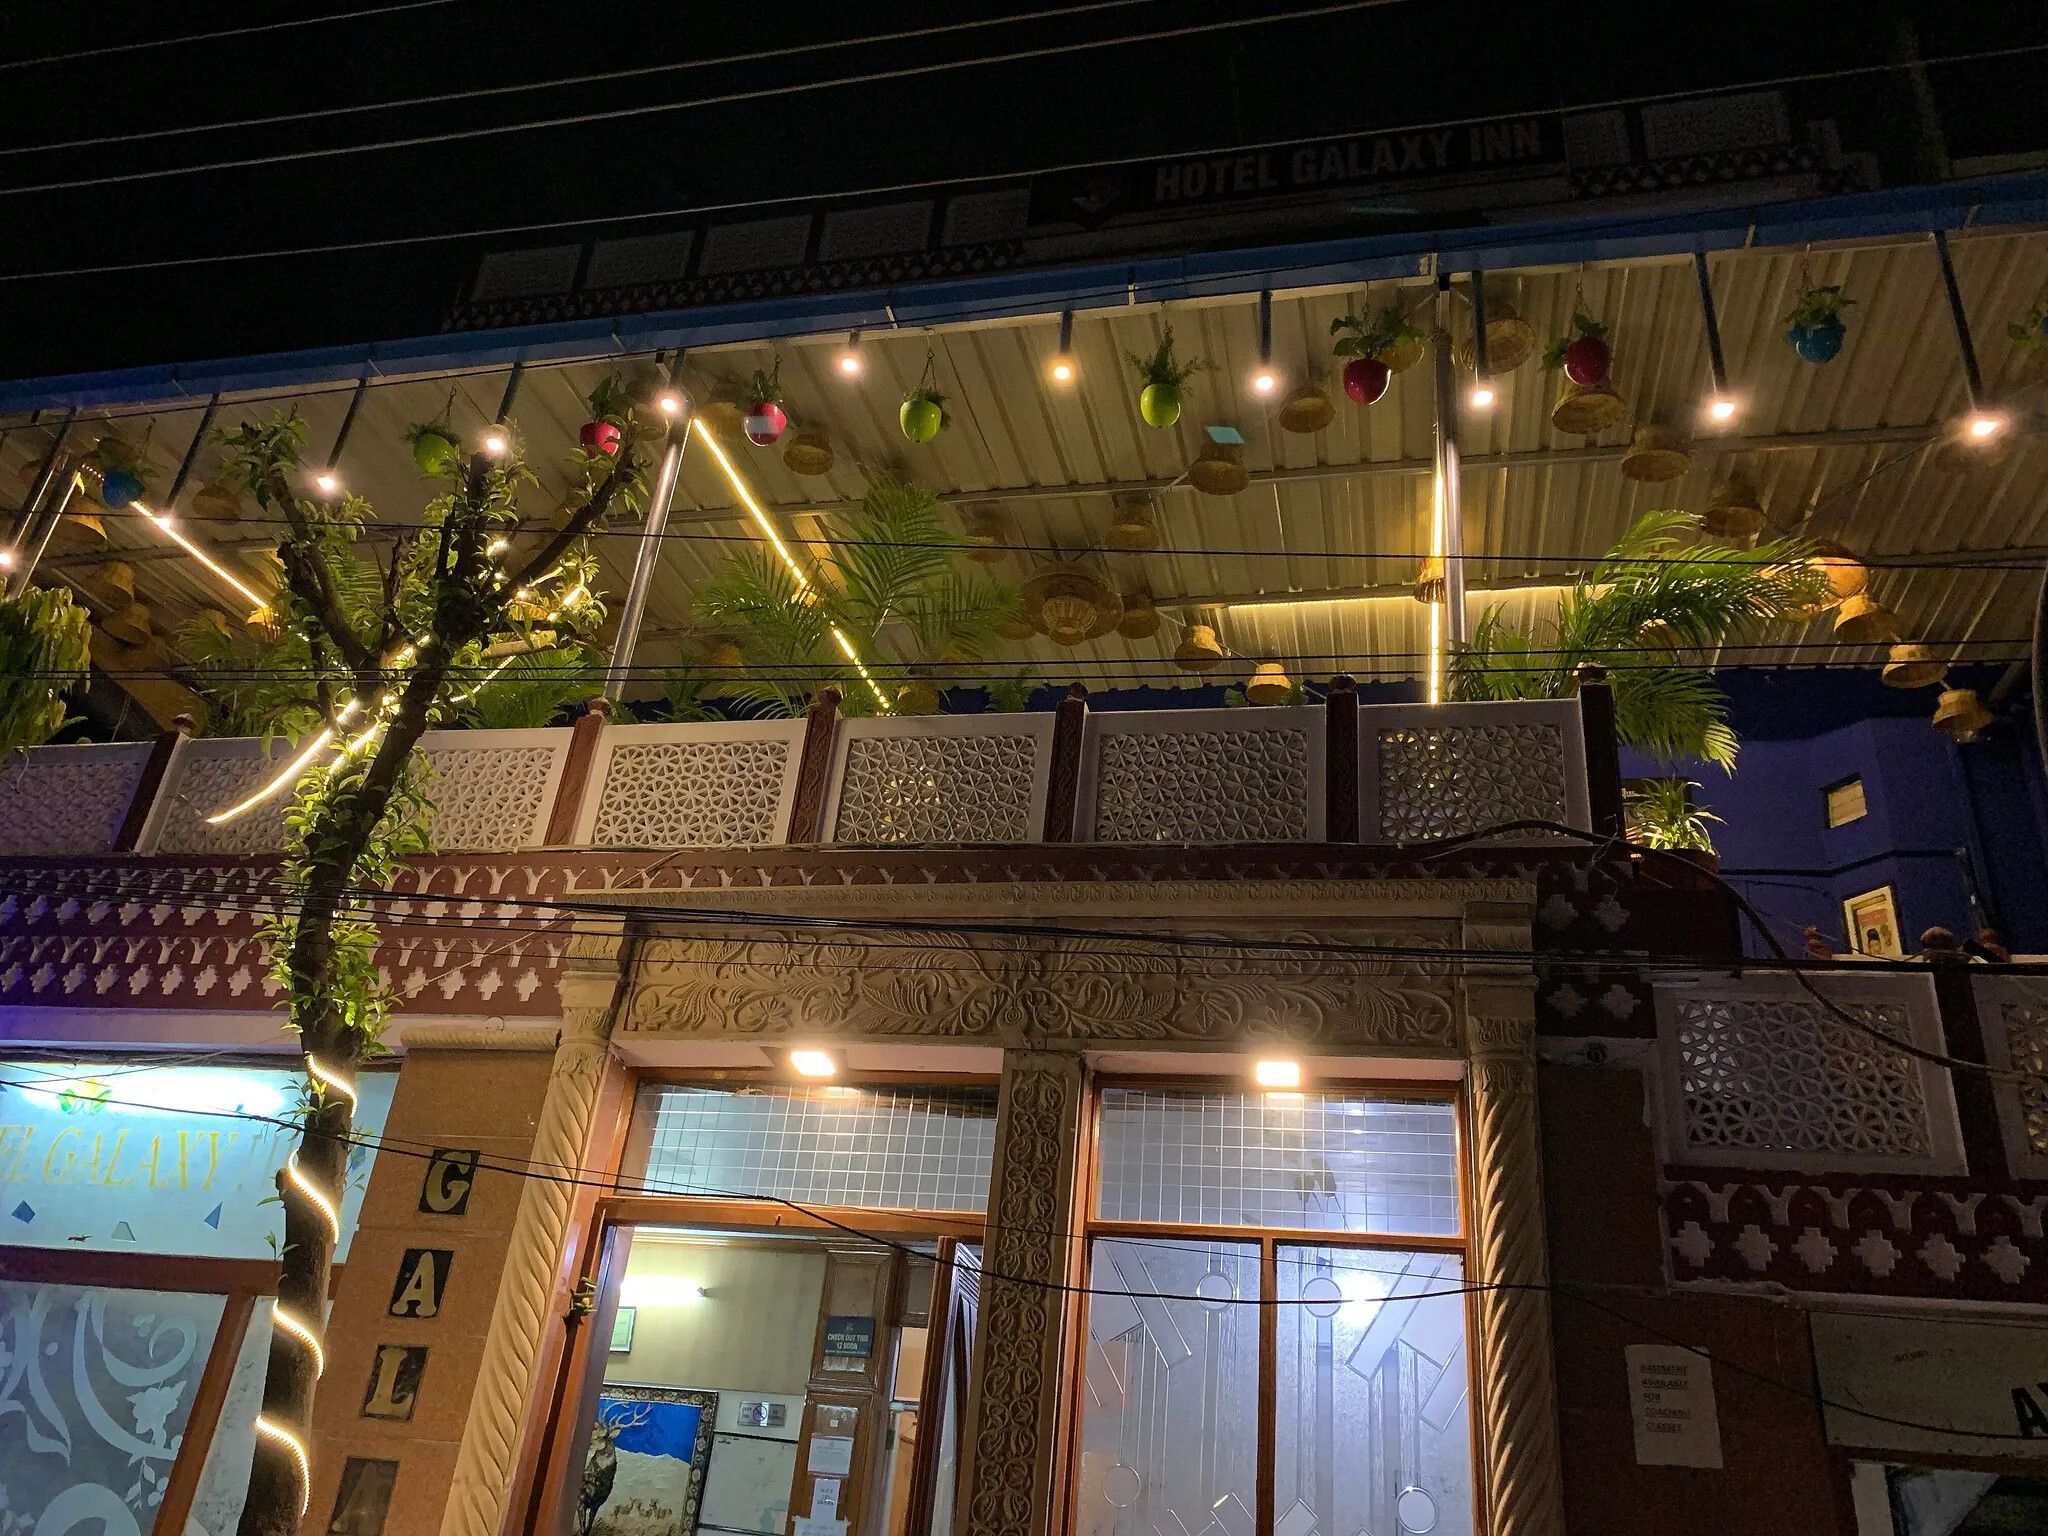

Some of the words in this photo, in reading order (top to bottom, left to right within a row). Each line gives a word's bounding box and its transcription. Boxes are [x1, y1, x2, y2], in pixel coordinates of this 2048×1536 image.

[1155, 153, 1279, 202] HOTEL
[1291, 130, 1453, 184] GALAXY
[1469, 119, 1542, 162] INN
[42, 1127, 239, 1190] GALAXY
[827, 1333, 844, 1341] CHECK
[1643, 1392, 1661, 1403] FOR
[2010, 1382, 2048, 1439] A
